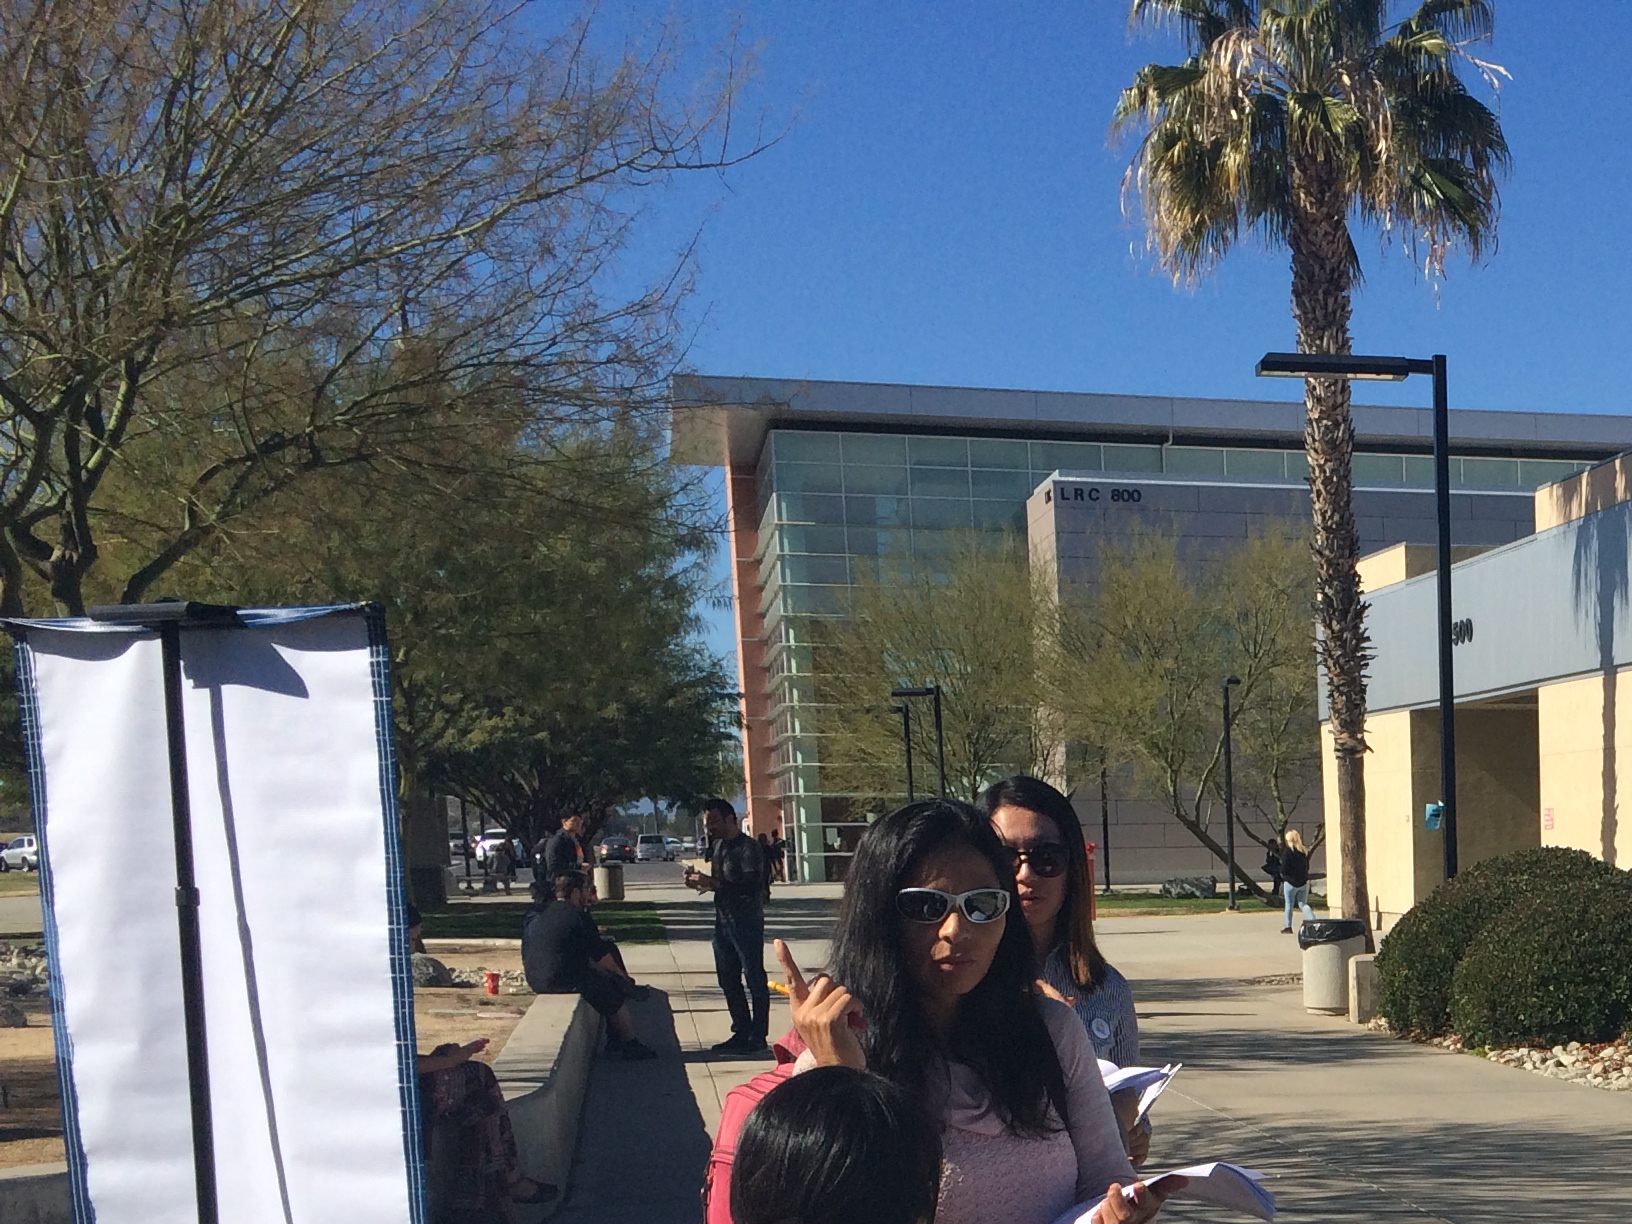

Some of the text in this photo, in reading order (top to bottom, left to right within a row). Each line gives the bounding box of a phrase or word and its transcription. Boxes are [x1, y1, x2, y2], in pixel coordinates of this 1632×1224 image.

[1060, 487, 1101, 502] LRC
[1110, 488, 1142, 502] 800
[1451, 618, 1474, 647] 500
